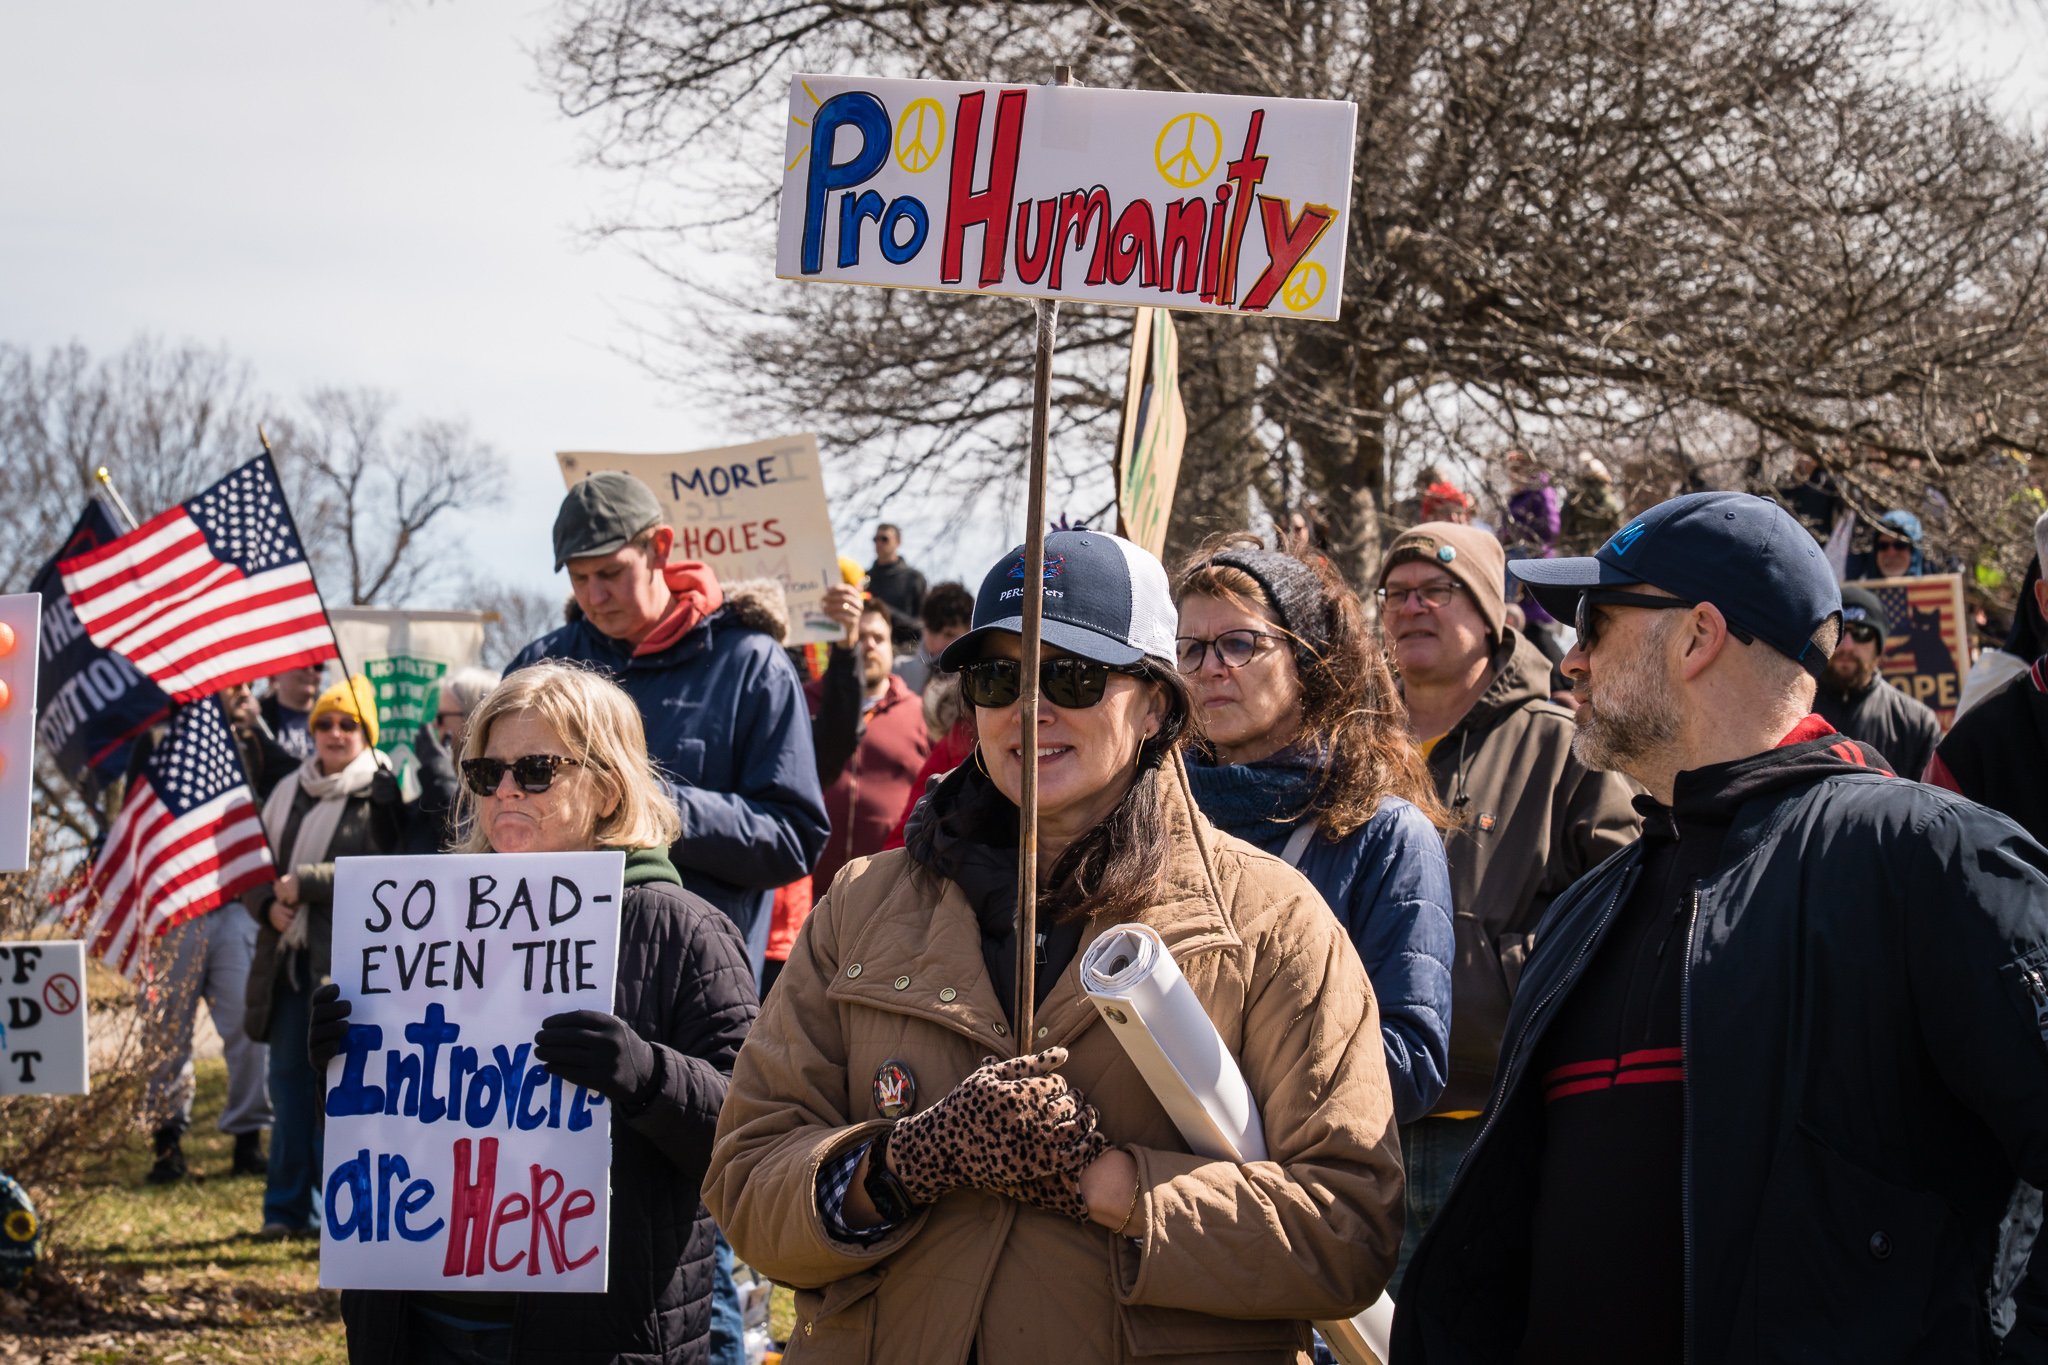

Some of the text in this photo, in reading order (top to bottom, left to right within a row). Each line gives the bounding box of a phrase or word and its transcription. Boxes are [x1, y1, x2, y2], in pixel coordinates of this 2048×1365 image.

[801, 89, 1339, 311] Pro Humanity
[671, 456, 777, 500] MORE
[365, 875, 612, 933] SO BAD-
[361, 937, 598, 995] EVEN THE
[325, 1148, 445, 1242] are
